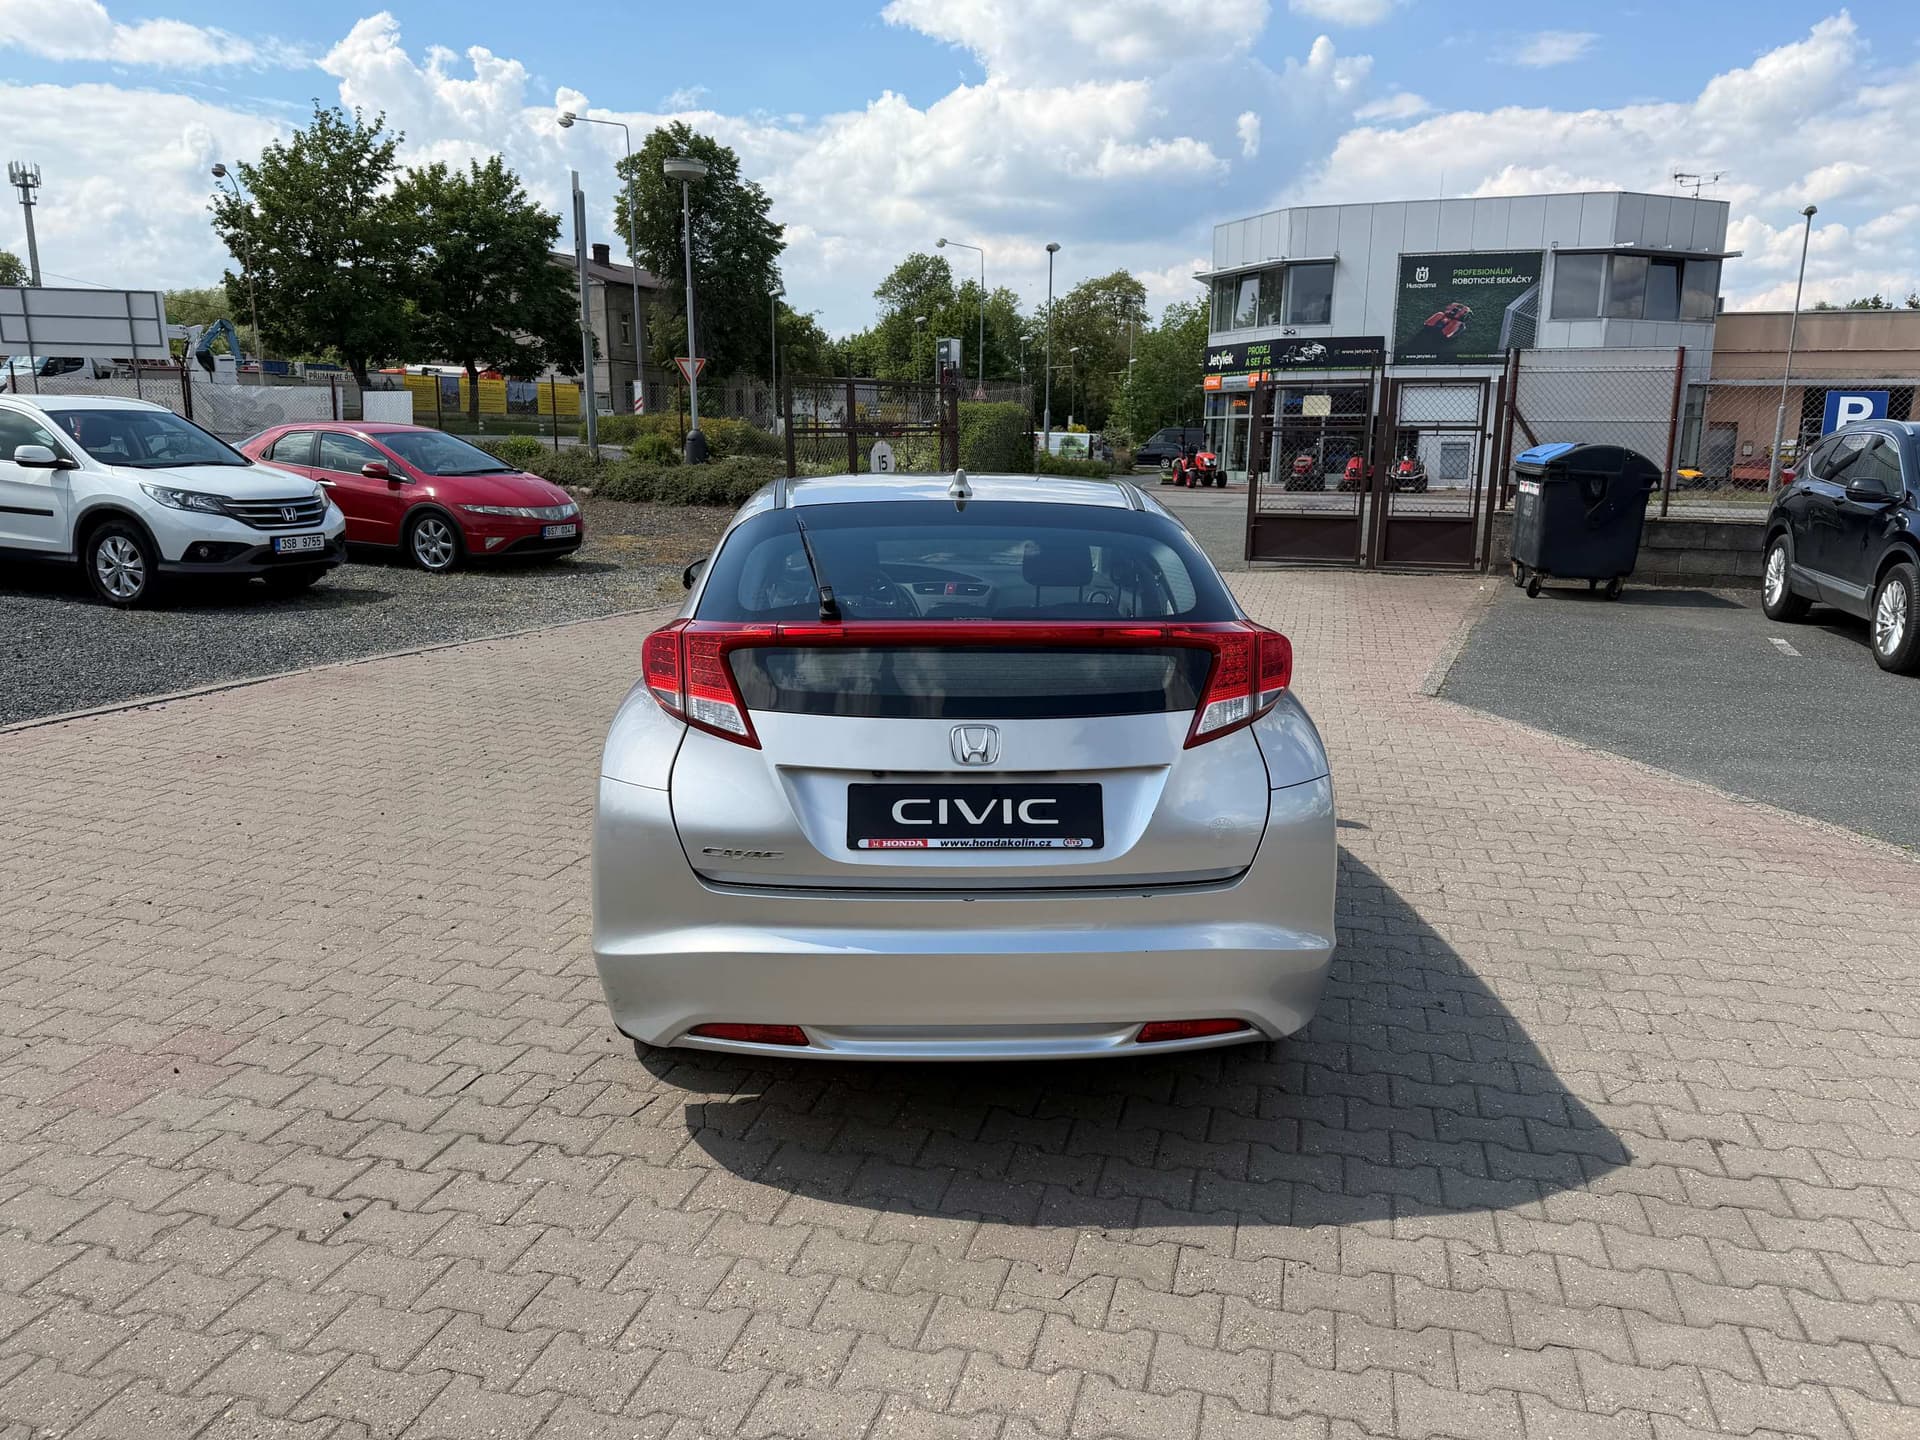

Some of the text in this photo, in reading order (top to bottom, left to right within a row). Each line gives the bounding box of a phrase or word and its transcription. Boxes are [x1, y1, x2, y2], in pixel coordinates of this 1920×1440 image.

[1453, 267, 1513, 276] PROFESIONÁLNÍ
[1452, 275, 1533, 285] ROBOTICKÉ SEKAČKY
[1247, 344, 1271, 355] PRODEJ
[1245, 358, 1250, 367] A
[1836, 396, 1874, 432] P
[878, 454, 888, 472] 15
[282, 536, 321, 549] 3SB 9755
[891, 798, 1060, 825] CIVIC
[882, 839, 925, 847] HONDA
[940, 838, 1053, 848] www.hondakolin.cz
